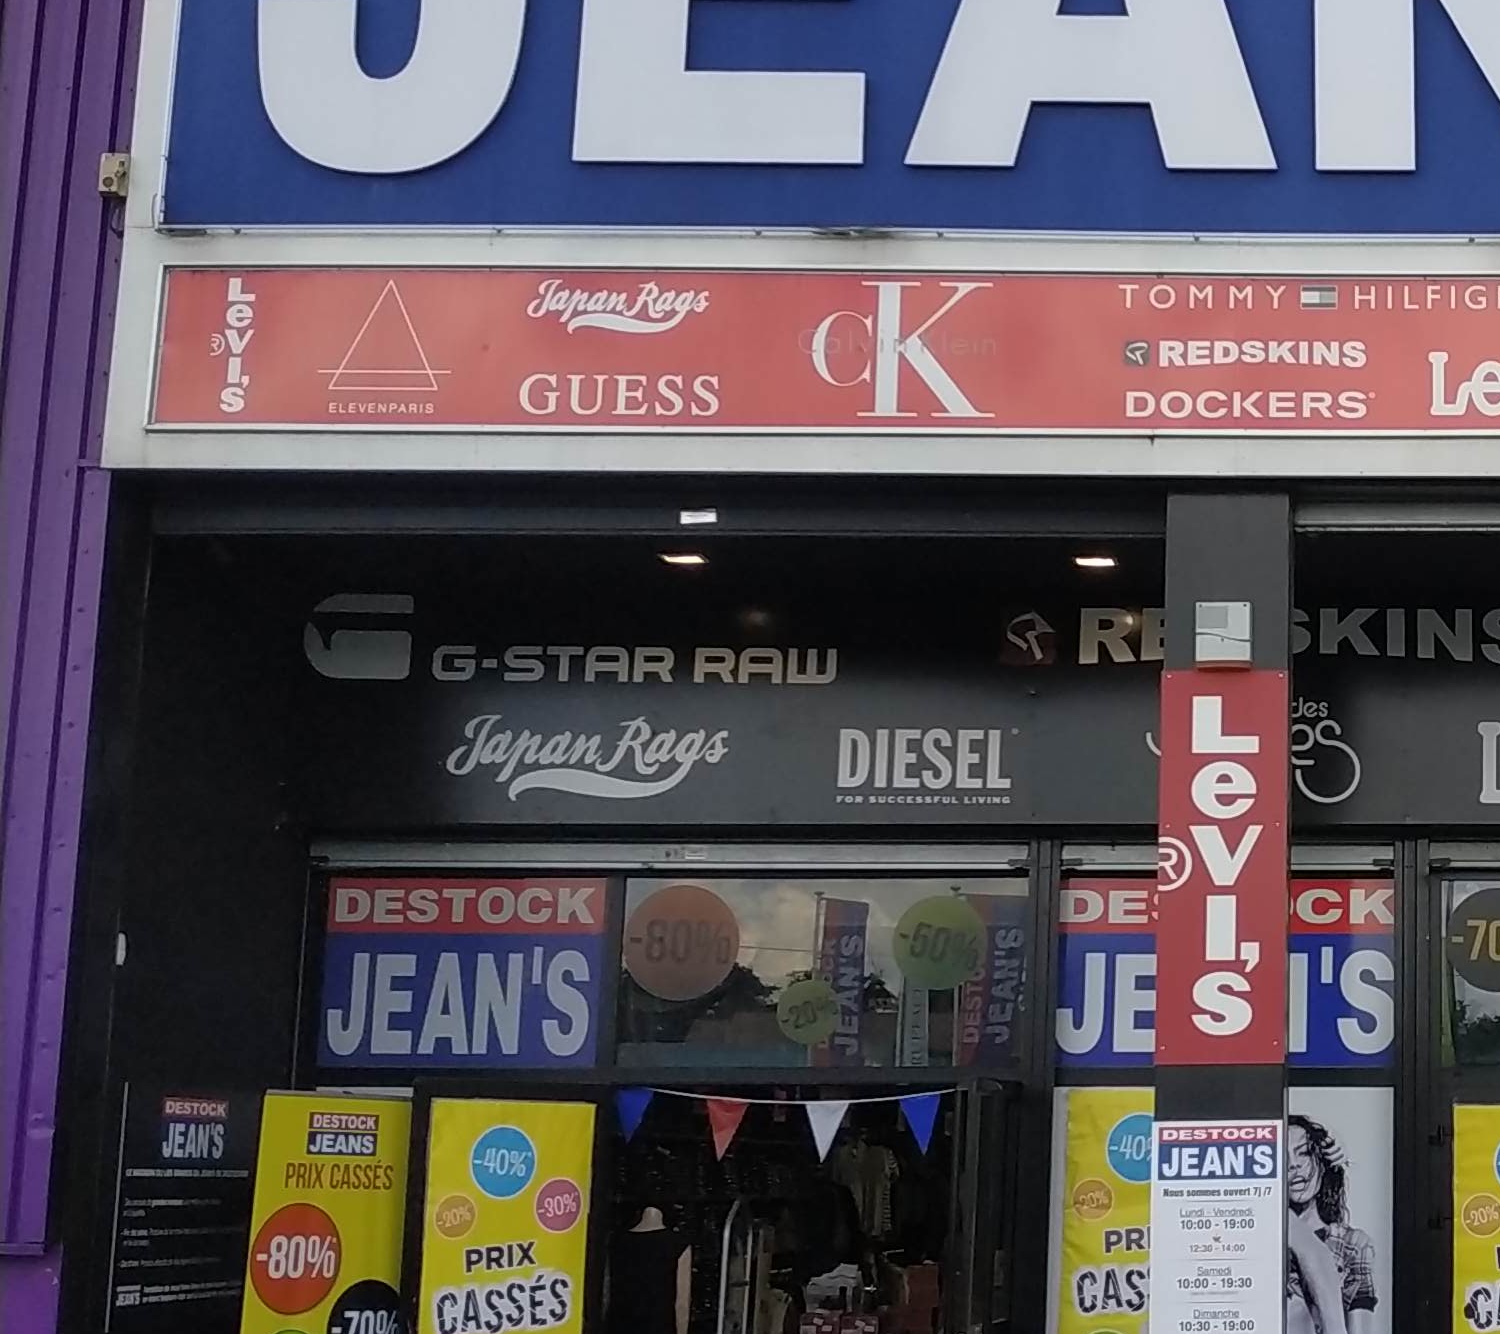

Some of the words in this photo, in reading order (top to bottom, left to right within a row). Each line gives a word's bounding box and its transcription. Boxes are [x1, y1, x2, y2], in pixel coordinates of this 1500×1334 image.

[525, 278, 627, 323] Japan
[633, 281, 711, 319] Rags
[1119, 284, 1286, 309] TOMMY
[1158, 340, 1368, 368] REDSKINS
[328, 402, 435, 414] ELEVENPARIS
[518, 373, 721, 416] GUESS
[1125, 391, 1369, 419] DOCKERS
[432, 645, 673, 684] G-STAR
[692, 646, 838, 684] RAW
[445, 714, 601, 783] Japan
[603, 716, 730, 771] Rags
[836, 727, 1012, 789] DIESEL
[836, 795, 864, 804] FOR
[868, 795, 958, 804] SUCCESSFUL
[963, 795, 1011, 804] LIVING
[334, 887, 595, 925] DESTOCK
[629, 919, 731, 966] -80%
[326, 946, 591, 1057] JEAN'S
[165, 1101, 226, 1118] DESTOCK
[313, 1114, 376, 1129] DESTOCK
[161, 1123, 224, 1159] JEAN'S
[309, 1134, 374, 1154] JEANS
[1162, 1128, 1273, 1141] DESTOCK
[284, 1163, 325, 1188] PRIX
[329, 1160, 394, 1190] CASSÉS
[1161, 1144, 1274, 1177] JEAN'S
[1180, 1219, 1212, 1230] 10:00
[1223, 1218, 1255, 1229] 19:00
[465, 1242, 537, 1273] PRIX
[1177, 1278, 1209, 1289] 10:00
[1220, 1277, 1252, 1288] 19:30
[1179, 1321, 1211, 1332] 10:30
[1222, 1320, 1254, 1331] 19:00
